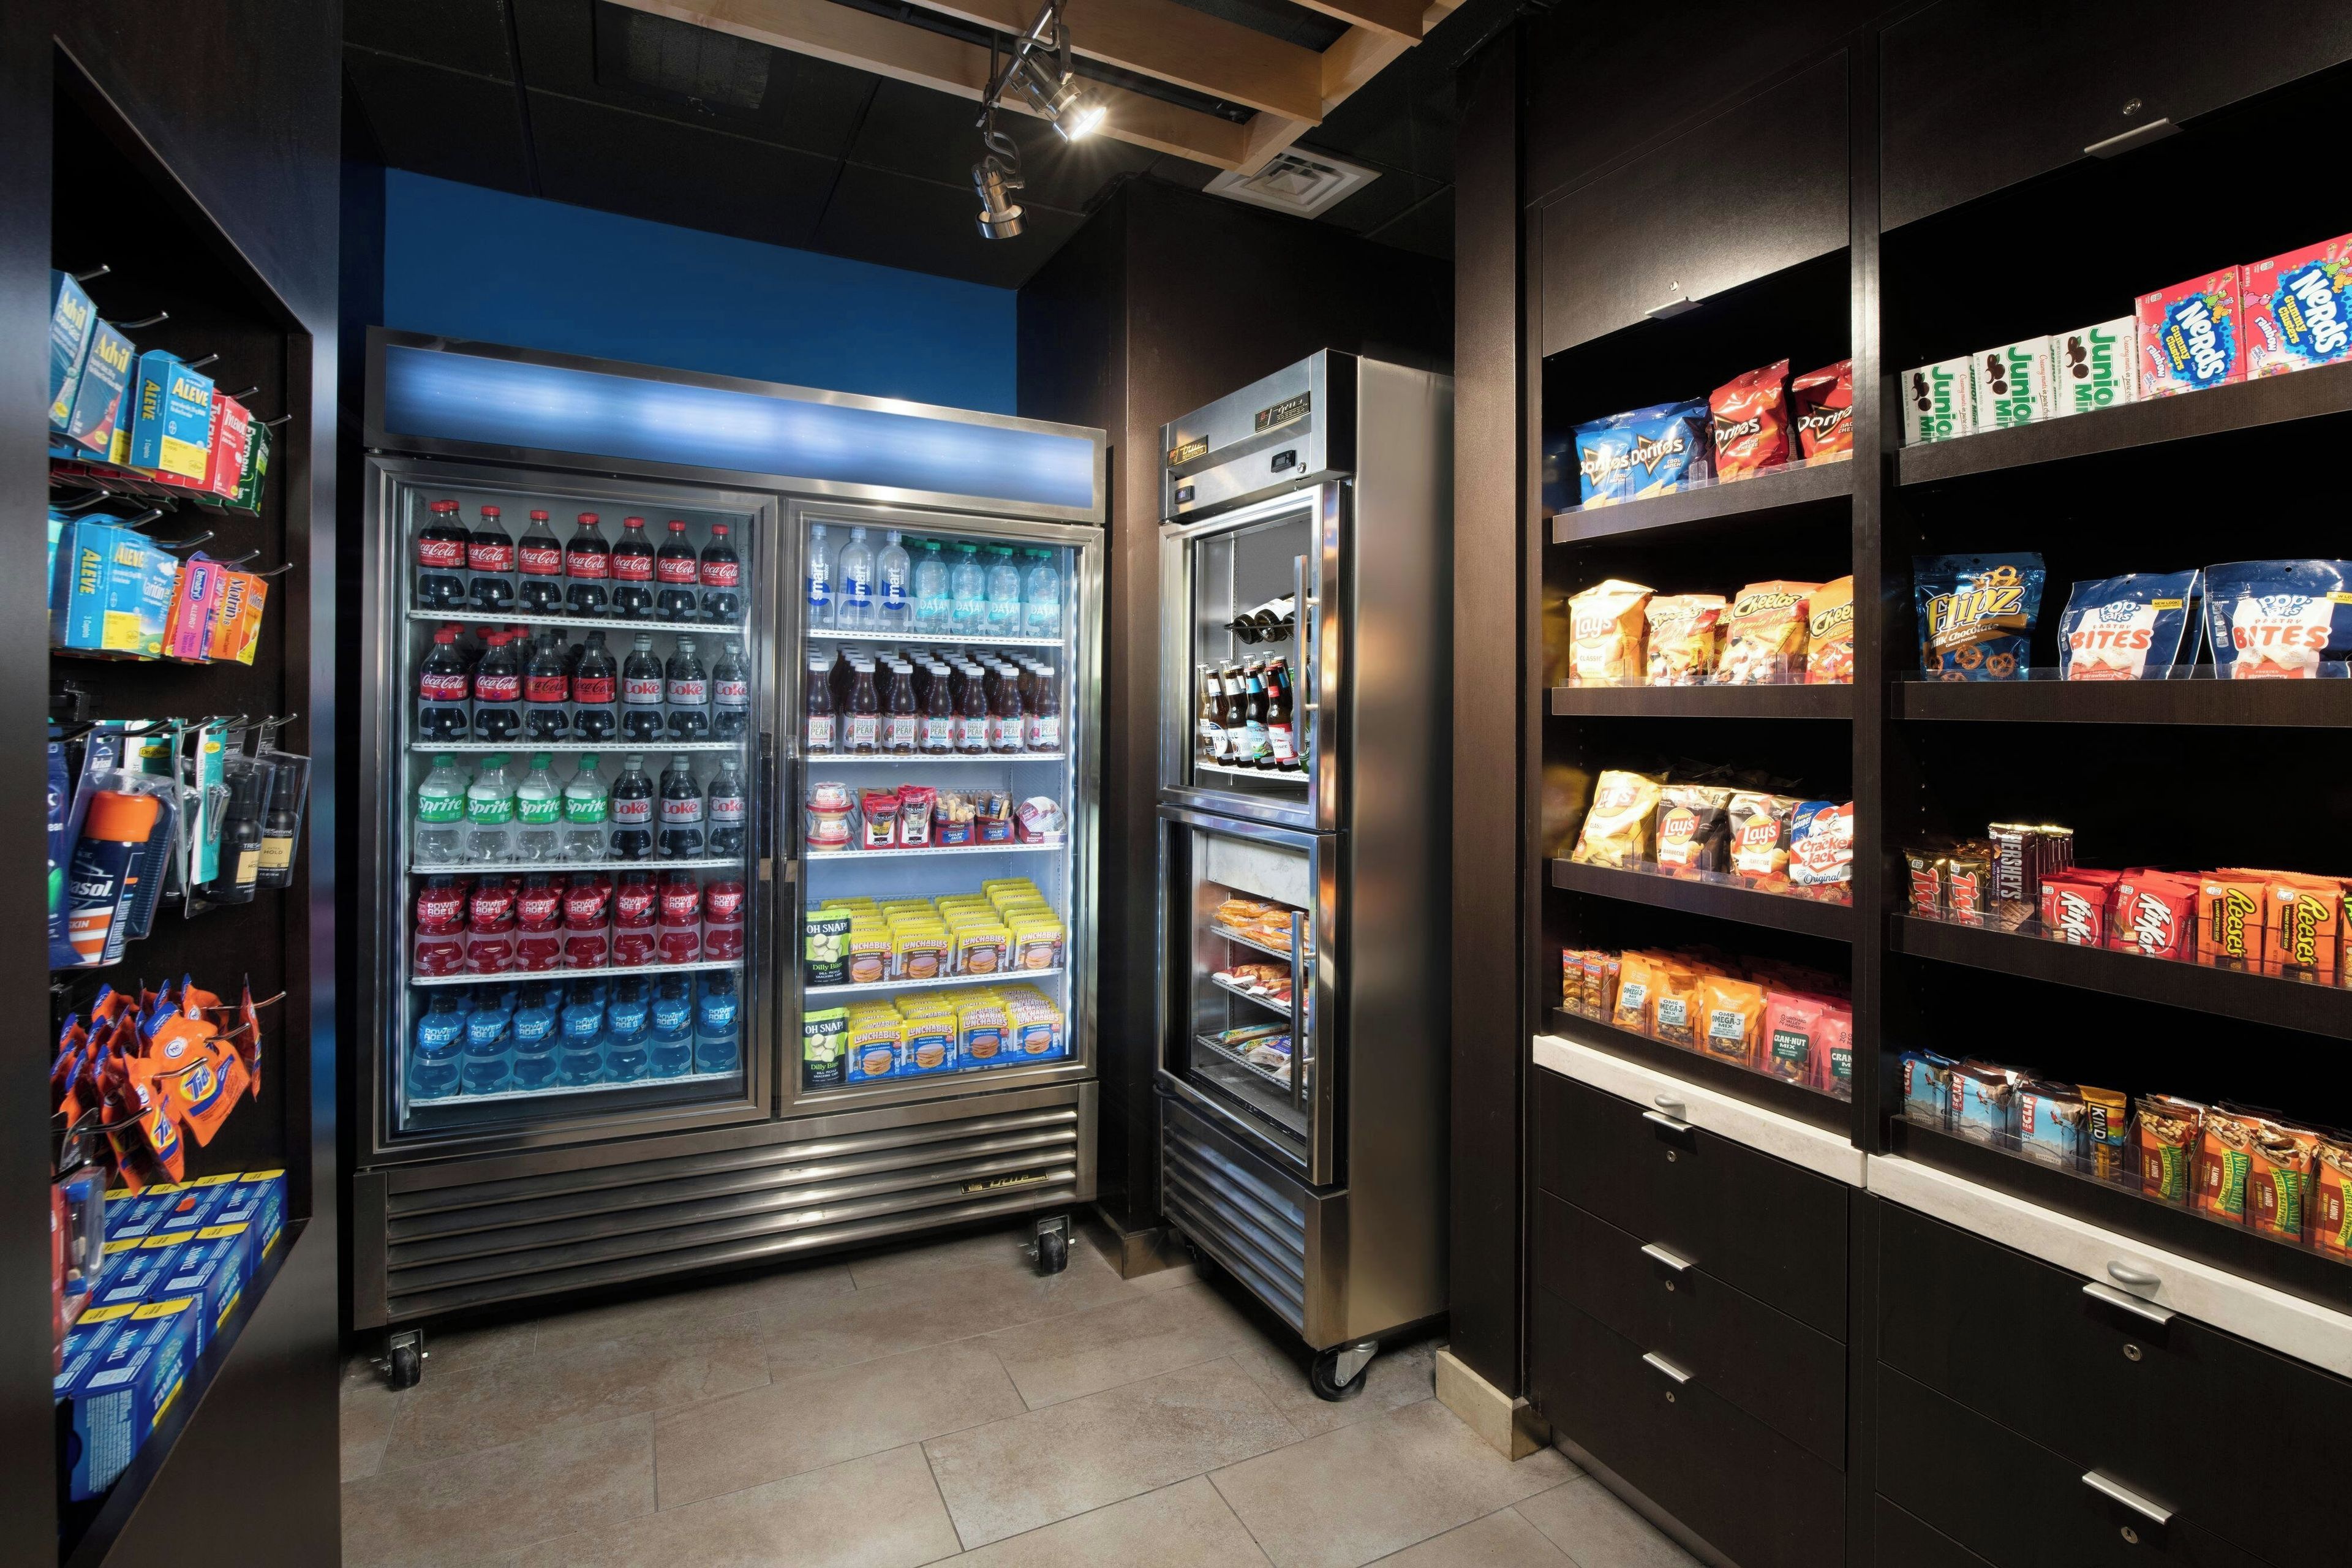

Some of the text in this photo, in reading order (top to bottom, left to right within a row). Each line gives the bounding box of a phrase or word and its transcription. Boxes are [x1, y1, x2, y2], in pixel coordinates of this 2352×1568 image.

[59, 290, 87, 331] Advil
[2285, 295, 2307, 332] Gummy
[2255, 316, 2277, 352] rainbow
[2278, 307, 2300, 344] Clusters
[2123, 336, 2132, 356] Creamy
[2171, 325, 2190, 360] Gummy
[94, 334, 130, 374] Advil
[2146, 345, 2165, 378] rainbow
[2166, 336, 2184, 371] Clusters
[2039, 354, 2048, 374] Creamy
[141, 379, 161, 421] ALEVE
[172, 377, 209, 409] ALEVE
[1632, 436, 1684, 467] Doritos
[519, 548, 560, 566] Coca-Cola
[567, 553, 606, 569] Coca-Cola
[612, 556, 652, 571] Coca-Cola
[658, 559, 696, 574] Coca-Cola
[79, 548, 102, 595] ALEVE
[194, 569, 206, 600] Benadryl
[889, 567, 900, 605] smart
[224, 576, 247, 619] Motrin
[1734, 592, 1803, 618] Cheetos
[189, 603, 199, 628] ALLERGY
[1927, 586, 2025, 636] Flipz
[1948, 622, 1999, 642] Chocolate
[2070, 629, 2151, 650] BITES
[2233, 626, 2329, 649] BITES
[422, 674, 464, 690] Coca-Cola
[477, 676, 519, 690] Coca-Cola
[624, 679, 660, 695] Coke
[667, 680, 703, 696] Coke
[419, 797, 462, 813] Sprite
[467, 799, 511, 815] Sprite
[521, 799, 561, 815] Sprite
[565, 799, 606, 815] Sprite
[614, 799, 648, 815] Coke
[661, 800, 698, 815] Coke
[1664, 817, 1695, 838] Lay's
[1742, 823, 1777, 845] Lay's
[1803, 850, 1838, 867] Jack
[2000, 834, 2022, 899] HERSHEY'S
[1803, 870, 1841, 885] Original
[428, 900, 459, 910] POWER
[571, 897, 601, 907] POWER
[806, 922, 848, 934] OH SNAP!
[2225, 888, 2257, 959] Reese's
[2295, 894, 2331, 965] Reese's
[902, 940, 948, 951] LUNCHABLES
[963, 935, 1006, 946] LUNCHABLES
[1020, 932, 1062, 943] LUNCHABLES
[805, 1020, 844, 1035] OH SNAP!
[908, 1024, 952, 1036] LUNCHABLES
[963, 1017, 1008, 1028] LUNCHABLES
[854, 1030, 902, 1044] LUNCHABLES
[1774, 1034, 1806, 1047] CRAN-NUT
[811, 1063, 825, 1071] Dilly
[1952, 1075, 1964, 1102] CLIF
[1952, 1102, 1963, 1110] BAR
[2022, 1095, 2037, 1124] CLIF
[2091, 1107, 2107, 1140] KIND
[2223, 1152, 2231, 1170] SWEET
[2210, 1166, 2220, 1187] ALMOND
[2272, 1170, 2283, 1188] SWEET
[2265, 1186, 2274, 1208] ALMOND
[2343, 1184, 2352, 1203] SWEET
[2329, 1199, 2340, 1220] ALMOND
[121, 1255, 148, 1281] TAMPAX
[180, 1246, 205, 1270] TAMPAX
[107, 1329, 139, 1363] TAMPAX
